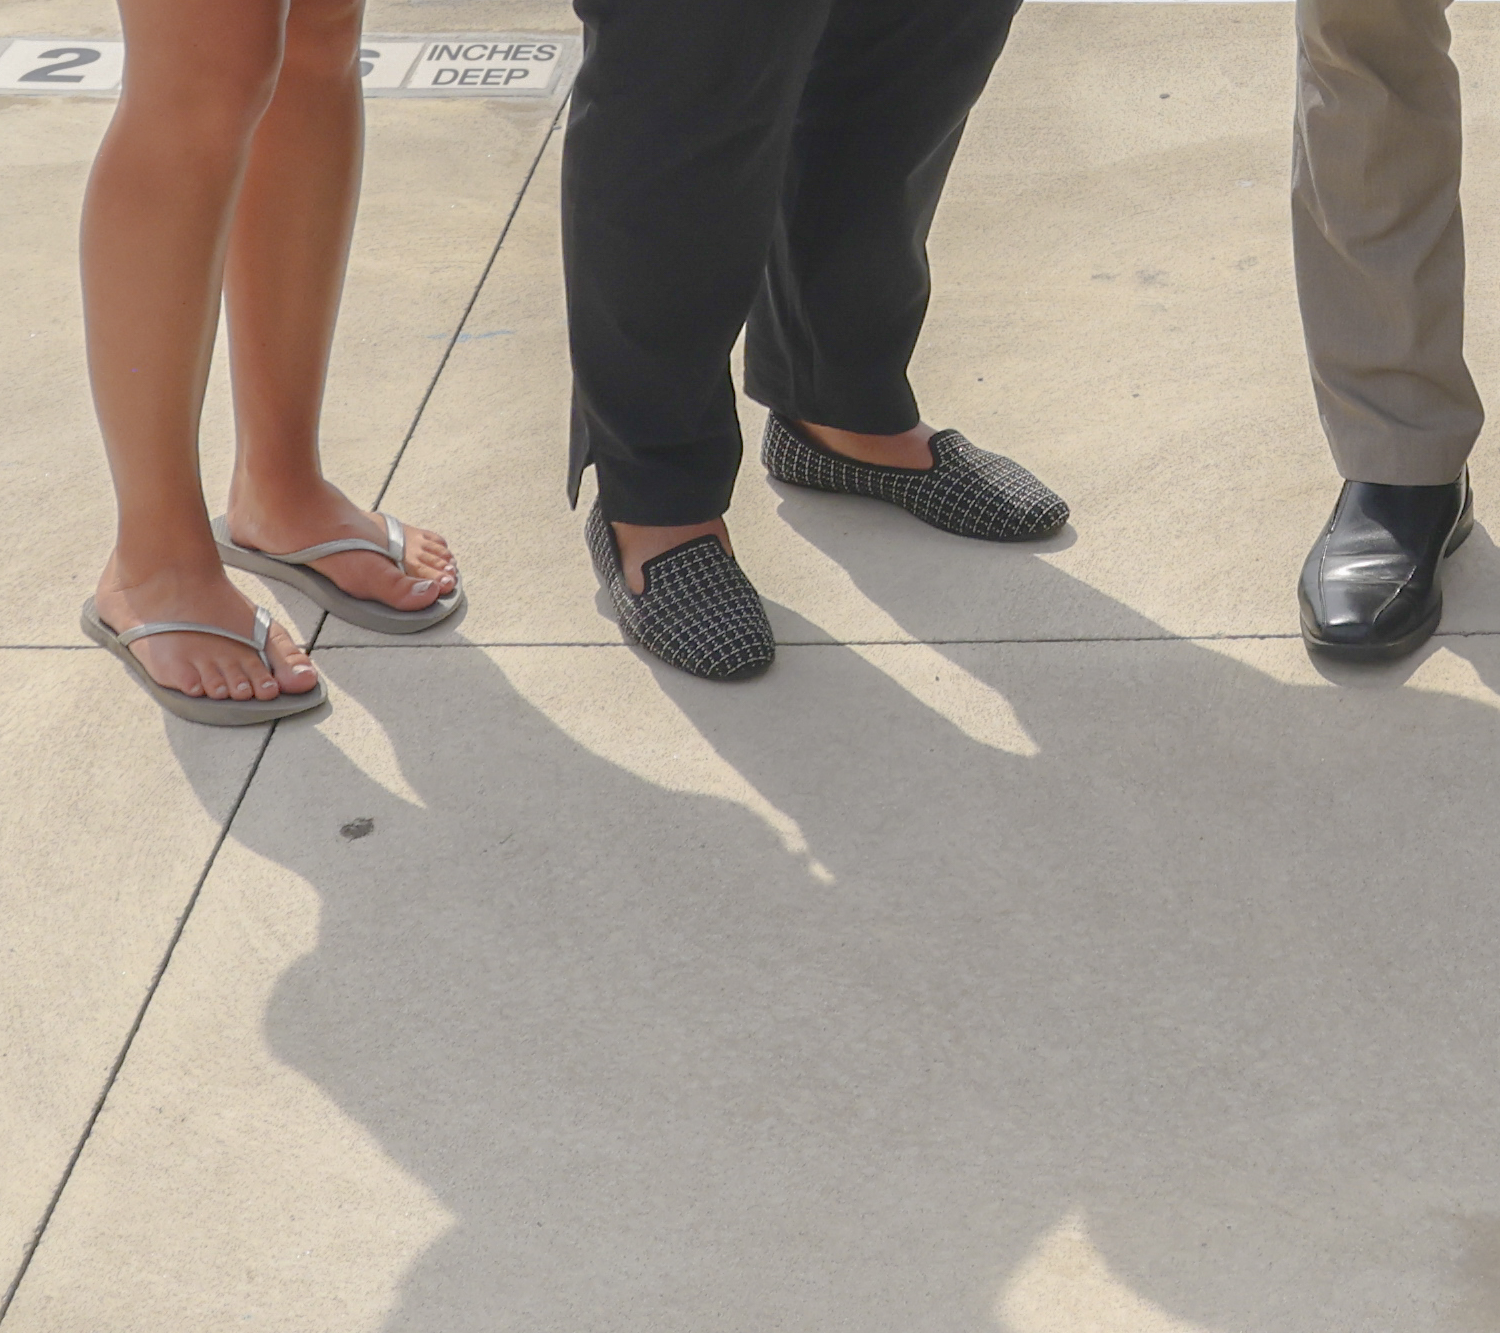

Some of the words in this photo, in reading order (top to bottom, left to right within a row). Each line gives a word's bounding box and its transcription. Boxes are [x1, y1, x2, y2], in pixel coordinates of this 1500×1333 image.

[426, 43, 557, 62] INCHES
[17, 47, 101, 83] 2
[431, 68, 530, 86] DEEP
